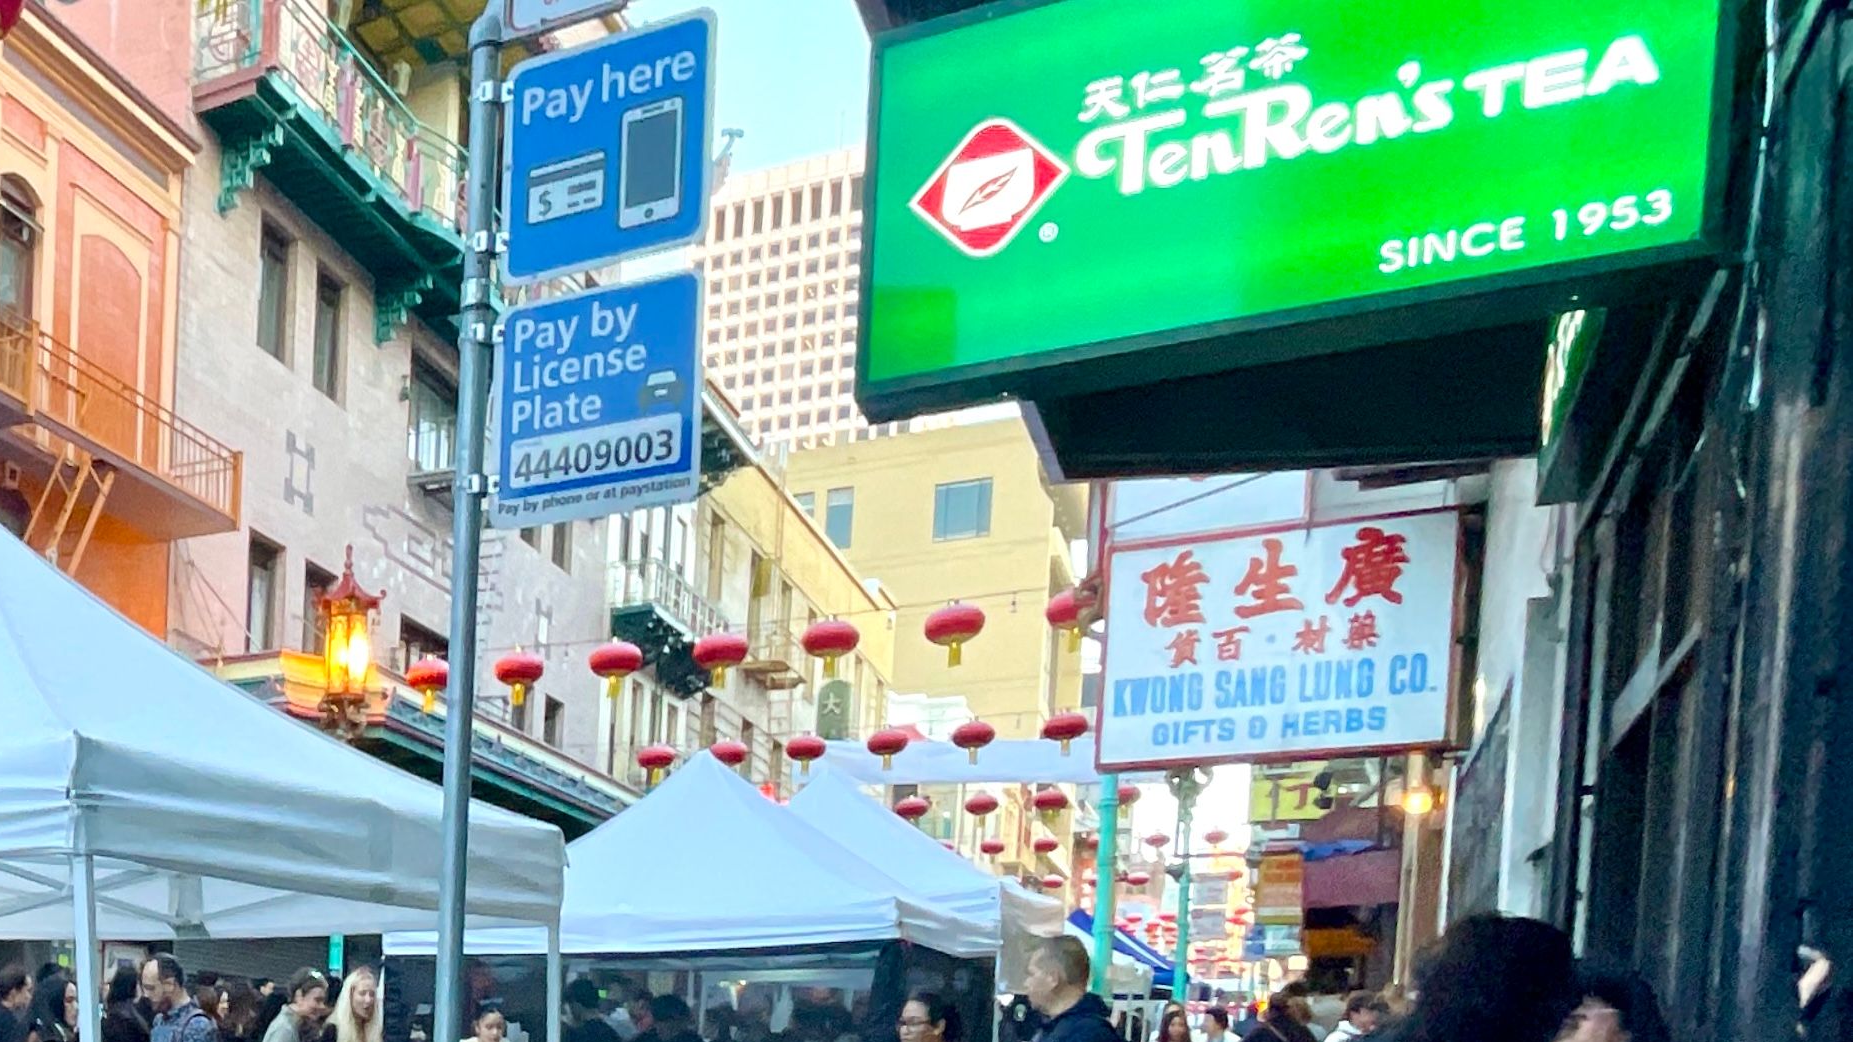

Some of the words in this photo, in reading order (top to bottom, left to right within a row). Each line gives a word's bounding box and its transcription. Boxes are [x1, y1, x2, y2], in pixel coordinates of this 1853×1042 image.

[521, 78, 594, 126] Pay
[601, 50, 696, 103] here
[1077, 32, 1309, 123] 天仁茗茶
[1462, 34, 1660, 118] TEA
[1378, 215, 1526, 273] SINCE
[1552, 189, 1673, 241] 1953
[514, 314, 580, 355] Pay
[591, 301, 638, 343] by
[514, 344, 647, 393] License
[512, 392, 602, 435] Plate
[514, 429, 674, 482] 44409003
[498, 502, 520, 516] Pay
[523, 500, 539, 513] by
[542, 492, 583, 511] phone
[586, 490, 601, 502] or
[603, 487, 617, 500] at
[620, 476, 691, 501] paystation
[1113, 669, 1204, 718] KWONG
[1215, 664, 1286, 710] SANG
[1299, 657, 1375, 702] LUNG
[1389, 652, 1439, 695] CO.
[1151, 716, 1236, 747] GIFTS
[1281, 705, 1387, 740] HERBS
